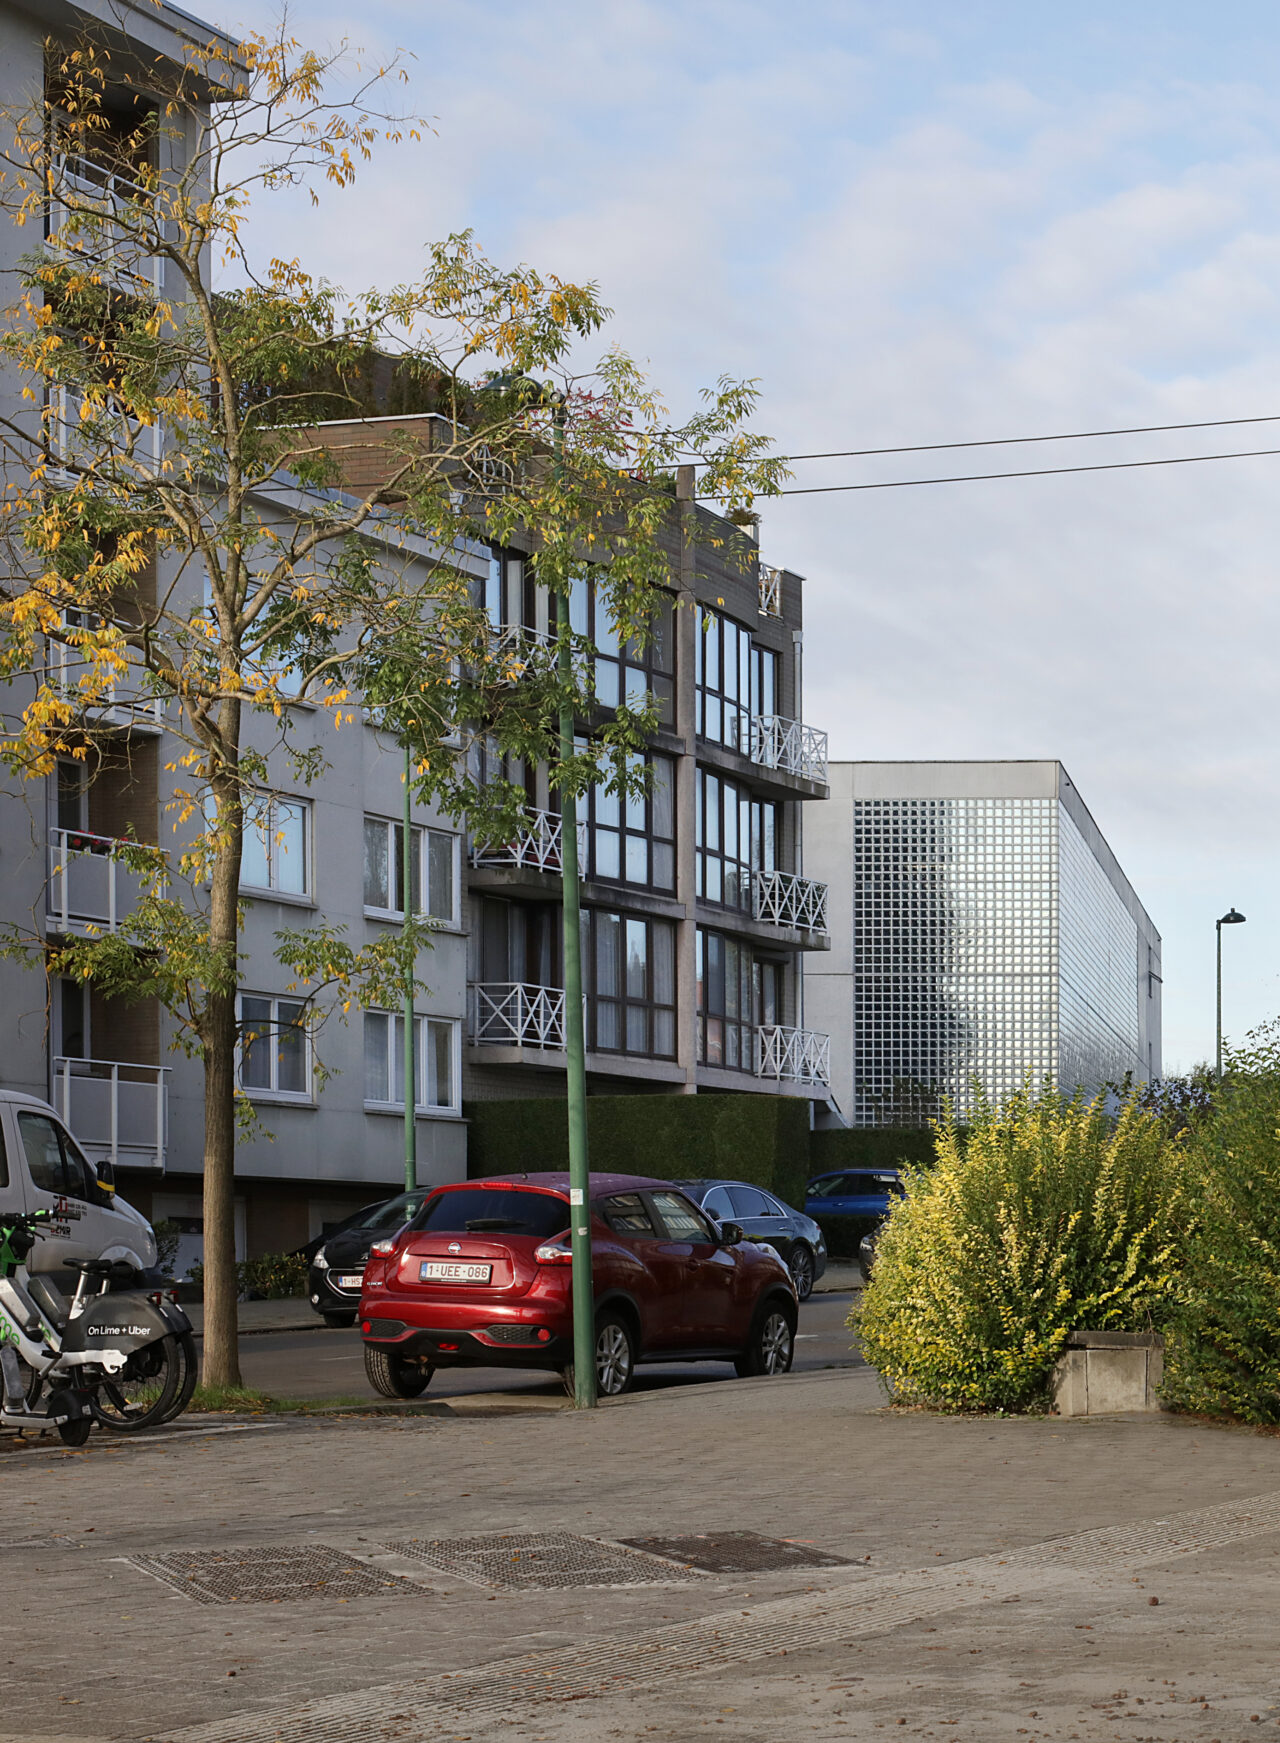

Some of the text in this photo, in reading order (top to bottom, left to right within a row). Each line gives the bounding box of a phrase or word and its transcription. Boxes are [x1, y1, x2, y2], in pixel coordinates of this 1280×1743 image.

[429, 1264, 489, 1278] 1-UEE-086
[343, 1277, 363, 1287] 1-HS
[88, 1326, 100, 1336] On
[100, 1325, 120, 1335] Lime
[128, 1325, 151, 1335] Uber
